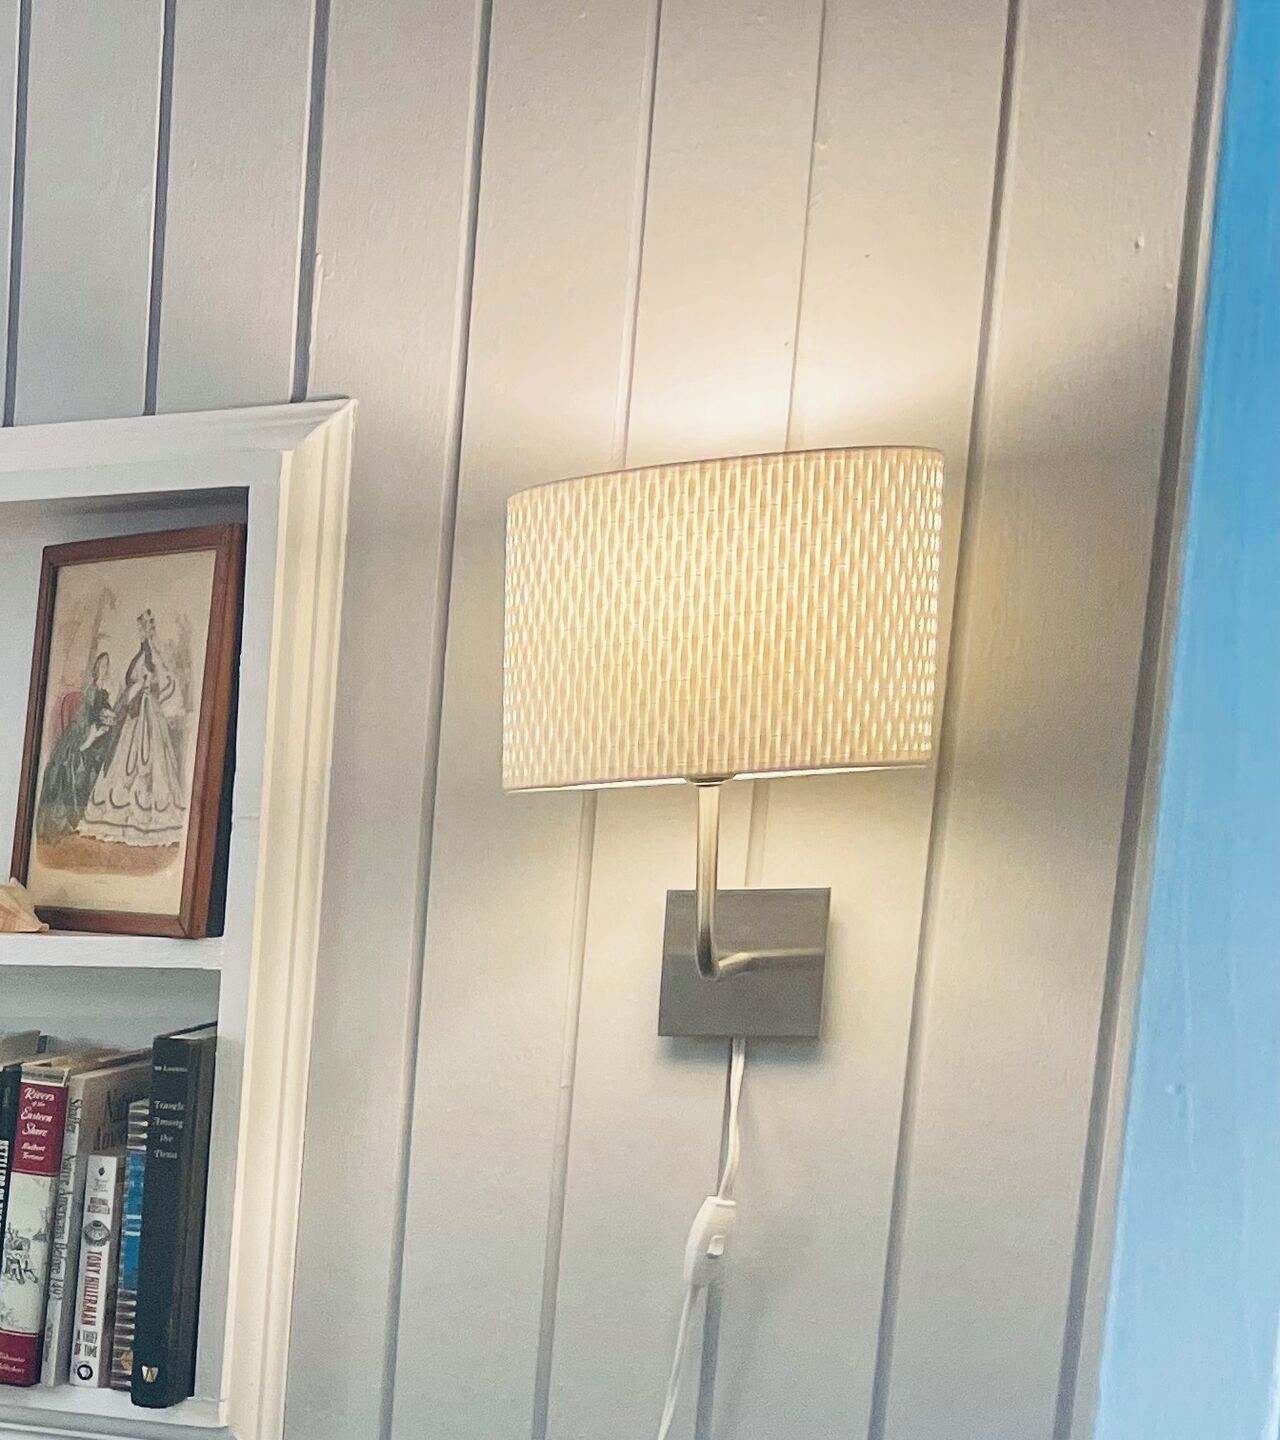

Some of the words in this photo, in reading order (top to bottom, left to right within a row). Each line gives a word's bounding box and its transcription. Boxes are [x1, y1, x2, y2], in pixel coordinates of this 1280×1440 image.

[24, 1087, 55, 1101] Rivers
[20, 1107, 53, 1122] Eastern
[154, 1101, 184, 1110] Travels
[22, 1122, 48, 1137] Shore
[61, 1153, 77, 1186] Native
[54, 1188, 73, 1240] Americans
[52, 1242, 67, 1274] Before
[86, 1250, 103, 1275] TONY
[81, 1276, 100, 1326] HILLERMAN
[84, 1345, 97, 1358] TIME
